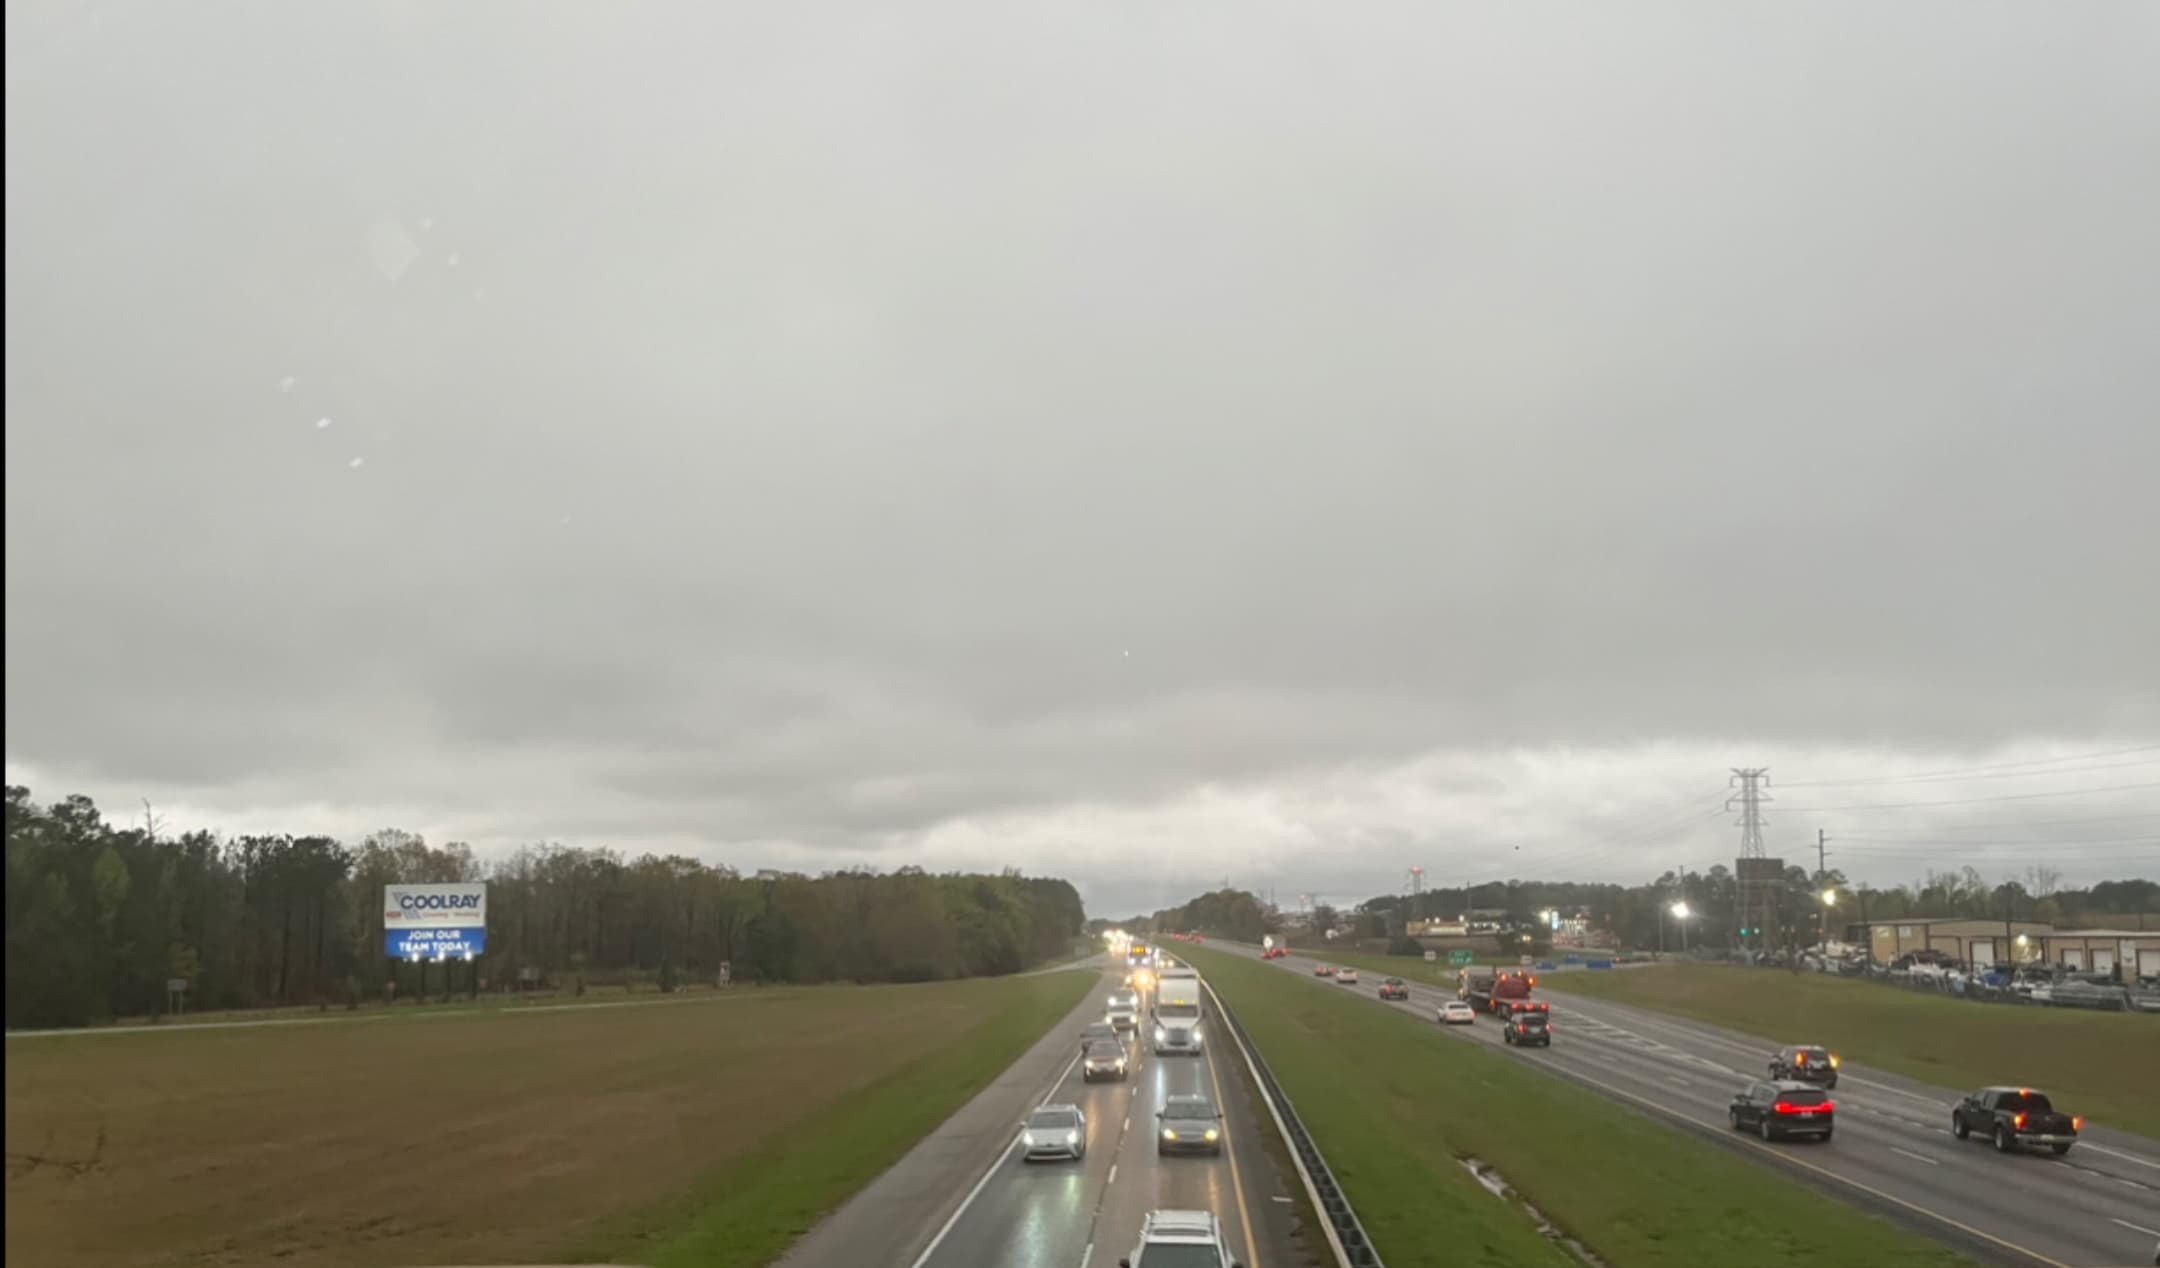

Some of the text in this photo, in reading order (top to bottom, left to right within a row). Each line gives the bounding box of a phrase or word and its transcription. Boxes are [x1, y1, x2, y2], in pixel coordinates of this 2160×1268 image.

[400, 894, 481, 909] COOLRAY
[408, 930, 461, 940] JOIN OUR
[398, 941, 471, 952] TEAM TODAY
